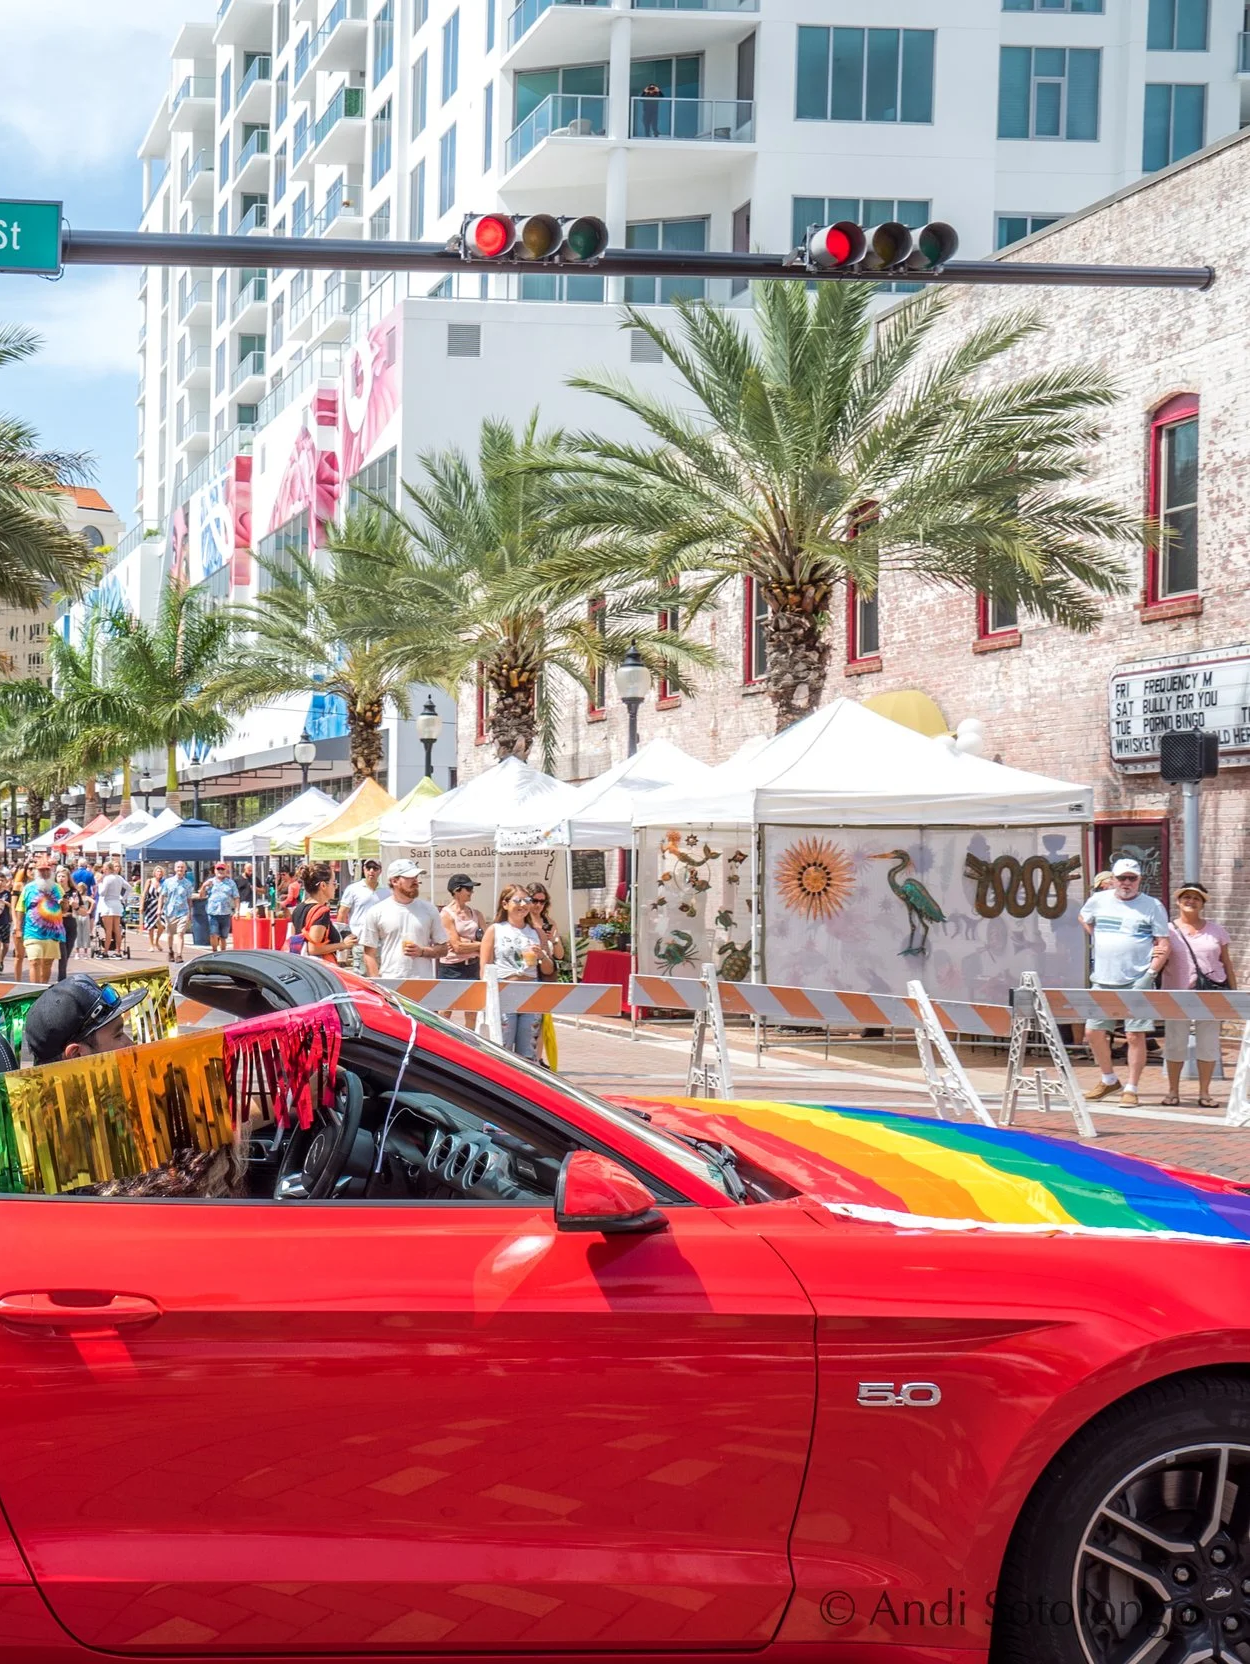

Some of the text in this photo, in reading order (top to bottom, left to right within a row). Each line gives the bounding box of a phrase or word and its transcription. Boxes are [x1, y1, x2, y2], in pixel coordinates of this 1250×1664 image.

[1115, 671, 1213, 699] FRI FREQUENCY M
[1115, 690, 1218, 717] SAT BULLY FOR YOU
[1115, 719, 1132, 735] TUE
[1143, 715, 1174, 733] PORNO
[1176, 712, 1205, 730] BINGO
[1115, 735, 1156, 754] WHISKEY
[460, 847, 497, 858] Candle
[472, 861, 504, 869] candls
[856, 1381, 942, 1407] 5.0
